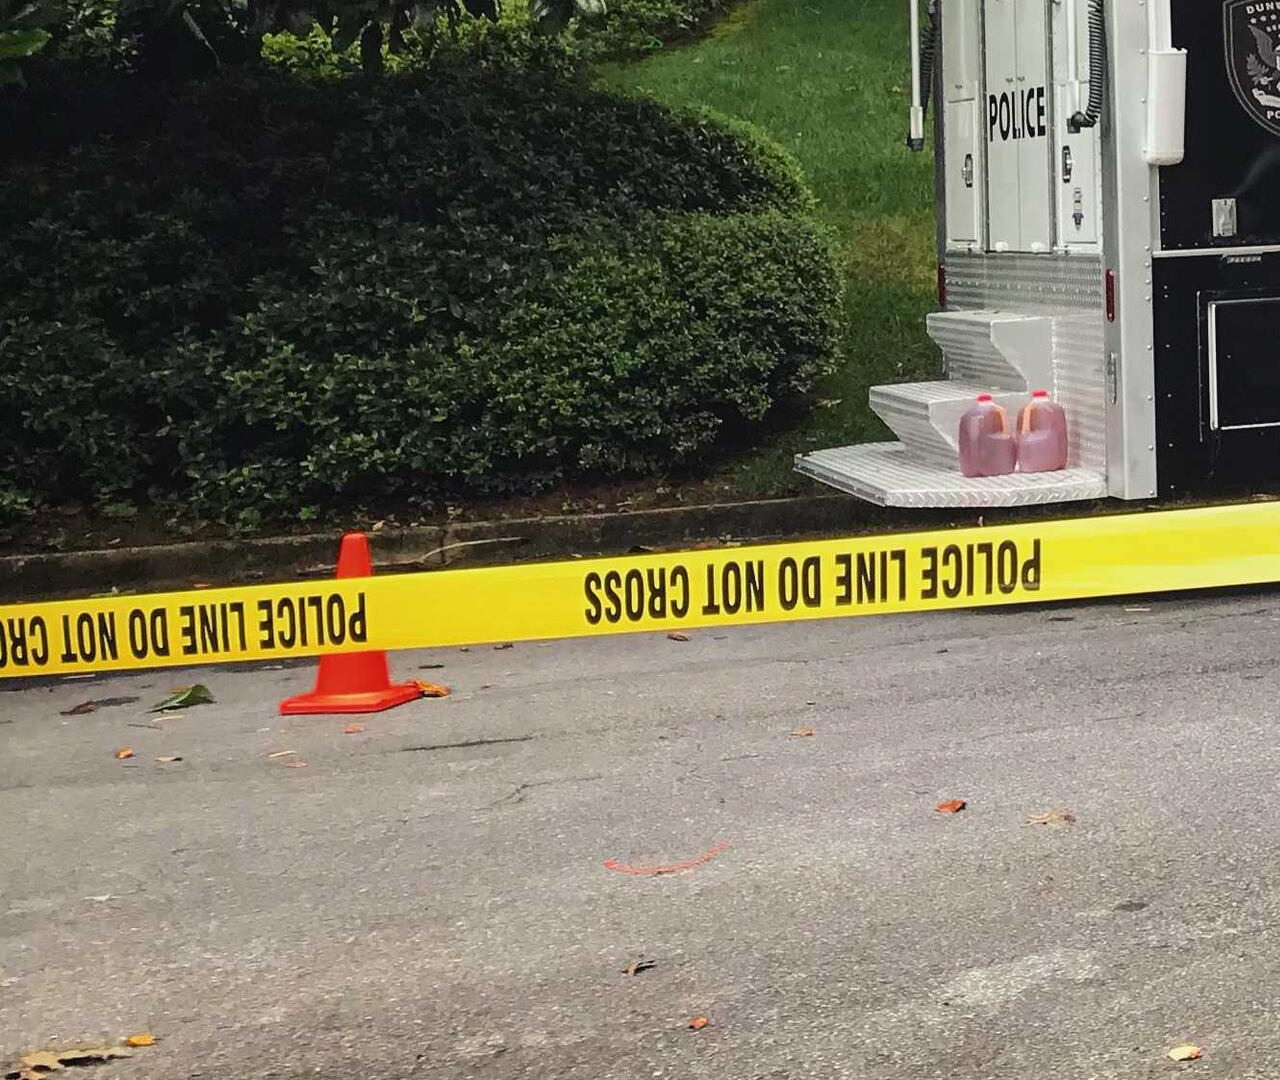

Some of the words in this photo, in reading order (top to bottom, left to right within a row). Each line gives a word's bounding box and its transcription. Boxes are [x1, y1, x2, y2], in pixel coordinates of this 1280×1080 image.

[989, 86, 1046, 142] POLICE
[584, 564, 690, 625] CROSS
[702, 560, 765, 615] NOT
[777, 555, 822, 610] DO
[835, 549, 907, 606] LINE
[920, 538, 1041, 599] POLICE
[61, 612, 119, 664] NOT
[129, 607, 170, 659] DO
[180, 602, 247, 655] LINE
[257, 592, 367, 650] POLICE
